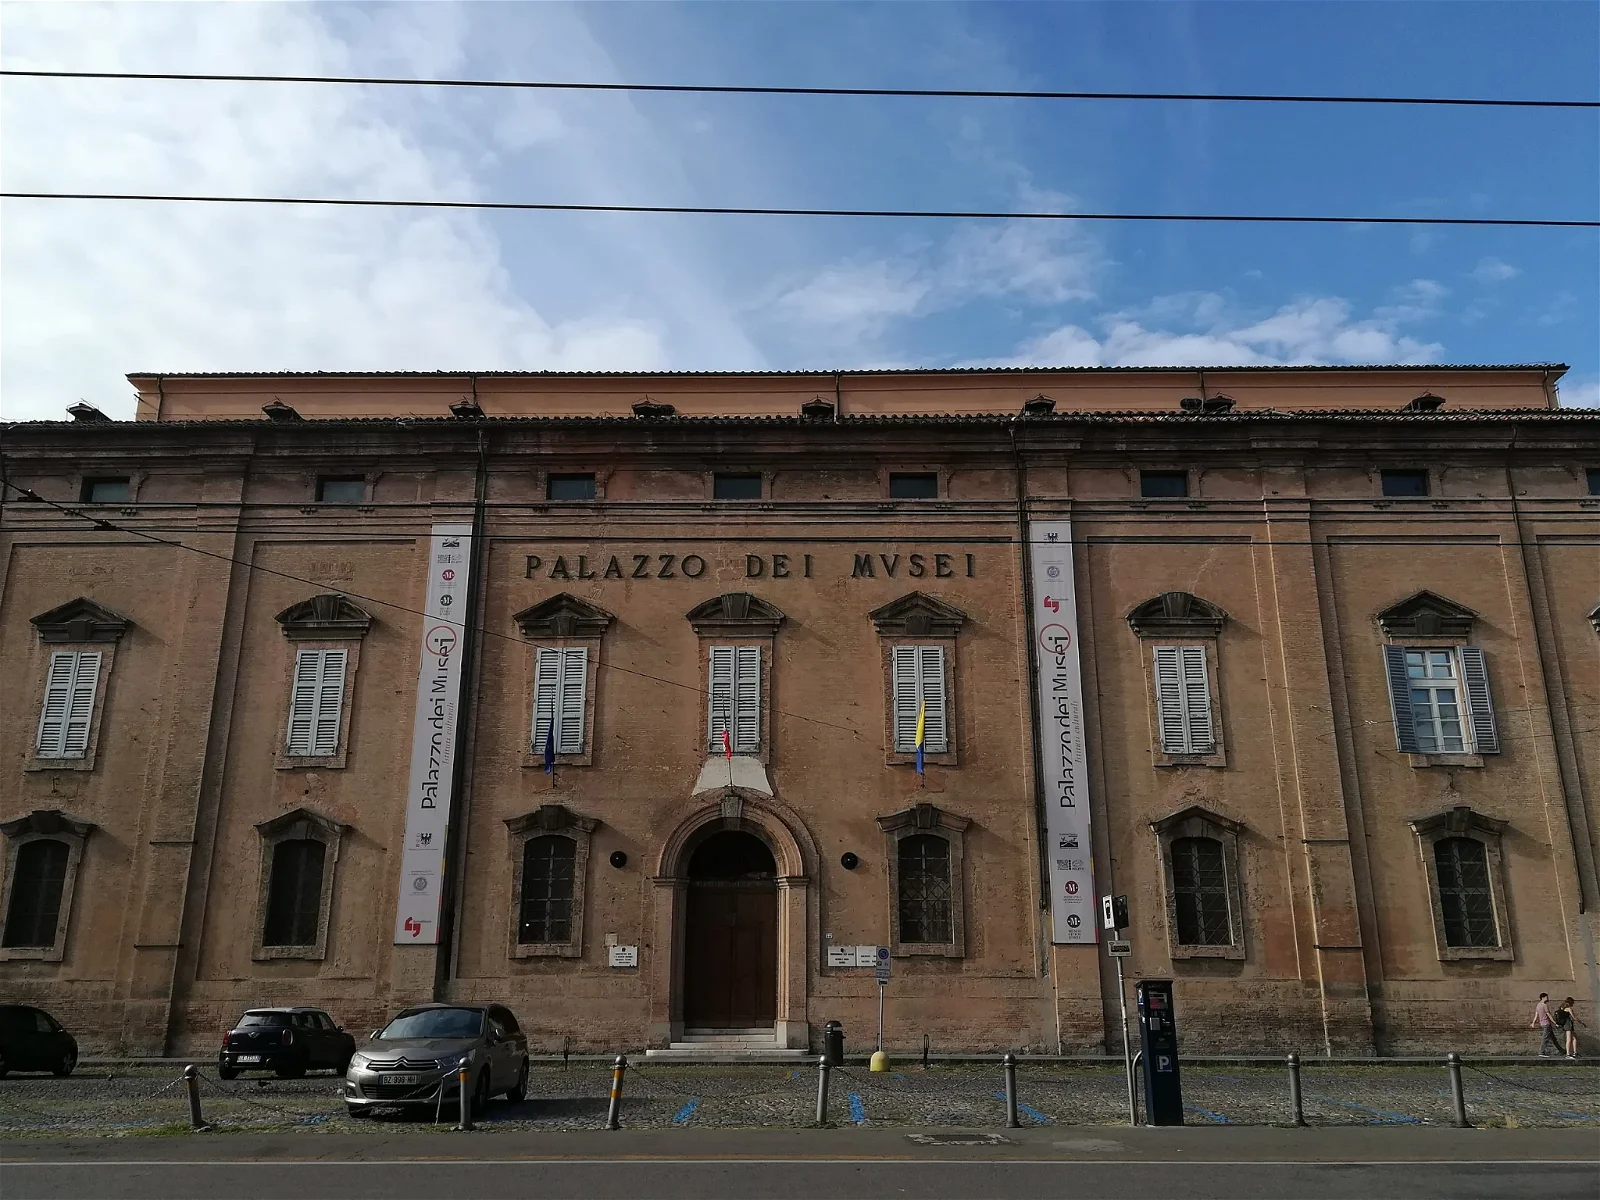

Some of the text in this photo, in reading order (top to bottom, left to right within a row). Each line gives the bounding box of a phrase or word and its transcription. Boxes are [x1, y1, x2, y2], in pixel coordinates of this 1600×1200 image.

[525, 553, 976, 579] PALAZZO DEI MVSEI
[431, 638, 455, 693] Musei
[428, 698, 445, 729] dei
[1048, 636, 1076, 808] Palazzo dei Musei
[421, 732, 443, 809] Palazzo
[1159, 1056, 1169, 1070] P
